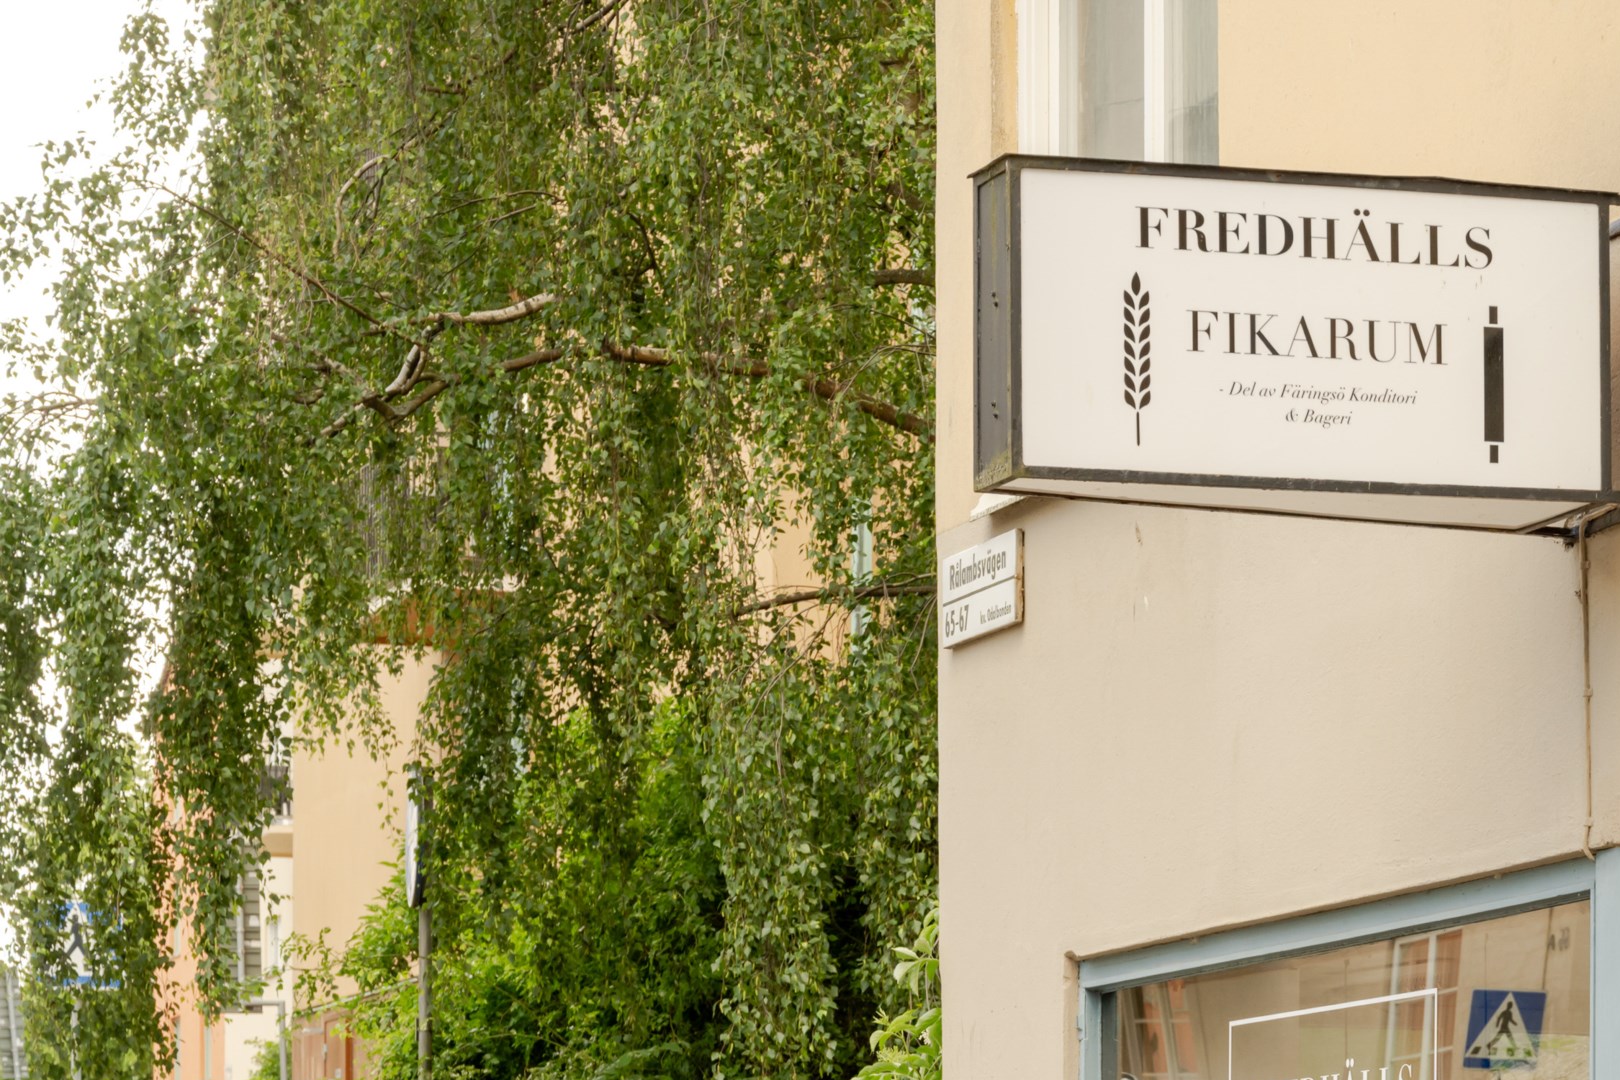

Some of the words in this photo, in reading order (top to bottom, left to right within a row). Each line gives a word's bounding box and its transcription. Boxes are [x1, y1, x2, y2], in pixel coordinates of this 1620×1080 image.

[1135, 205, 1494, 270] FREDHÄLLS
[1185, 309, 1449, 366] FIKARUM
[1228, 381, 1257, 396] Del
[1259, 387, 1277, 398] av
[1280, 384, 1345, 405] Färingsö
[1349, 387, 1419, 405] Konditori
[1285, 408, 1299, 423] &
[1303, 409, 1353, 429] Bageri
[949, 549, 1007, 590] Rålambsvägen
[945, 604, 970, 638] 65-67
